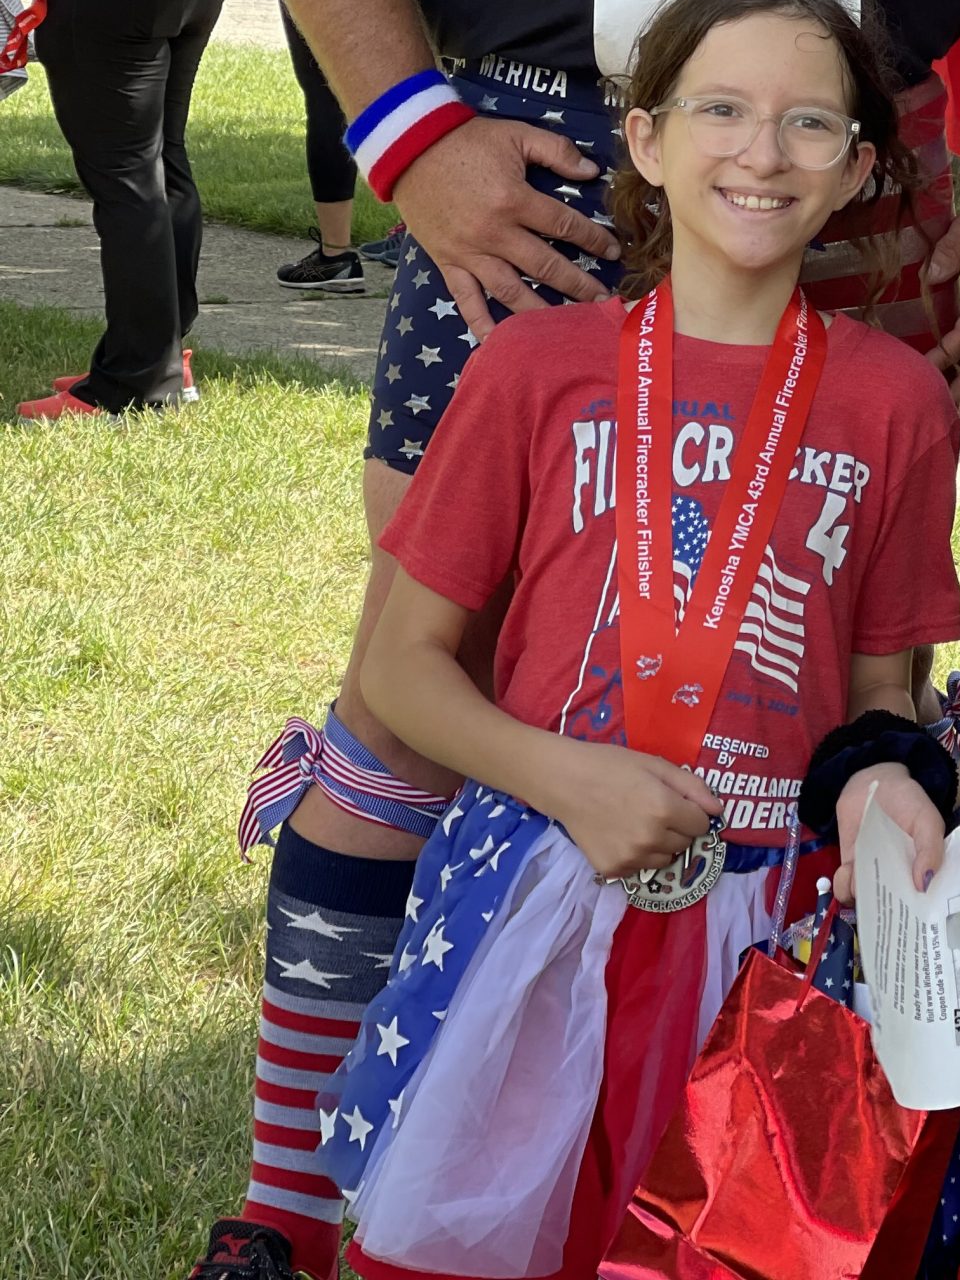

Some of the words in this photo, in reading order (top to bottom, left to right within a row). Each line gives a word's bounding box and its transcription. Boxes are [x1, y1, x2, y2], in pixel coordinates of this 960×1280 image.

[639, 295, 657, 336] YMCA
[638, 338, 653, 373] 43rd
[775, 329, 808, 408] Firecracker
[637, 376, 653, 430] Annual
[758, 408, 788, 465] Annual
[635, 434, 652, 526] Firecracker
[747, 463, 770, 501] 43rd
[728, 502, 759, 551] YMCA
[805, 491, 850, 587] 4
[637, 530, 653, 600] Finisher
[703, 554, 741, 629] Kenosha
[717, 751, 737, 769] By
[628, 887, 703, 911] FIRECRACKER
[699, 842, 726, 894] FINISHER
[933, 949, 942, 961] for
[936, 978, 945, 995] Code
[938, 996, 948, 1022] Coupon
[913, 999, 922, 1022] Ready
[925, 1008, 935, 1024] Visit
